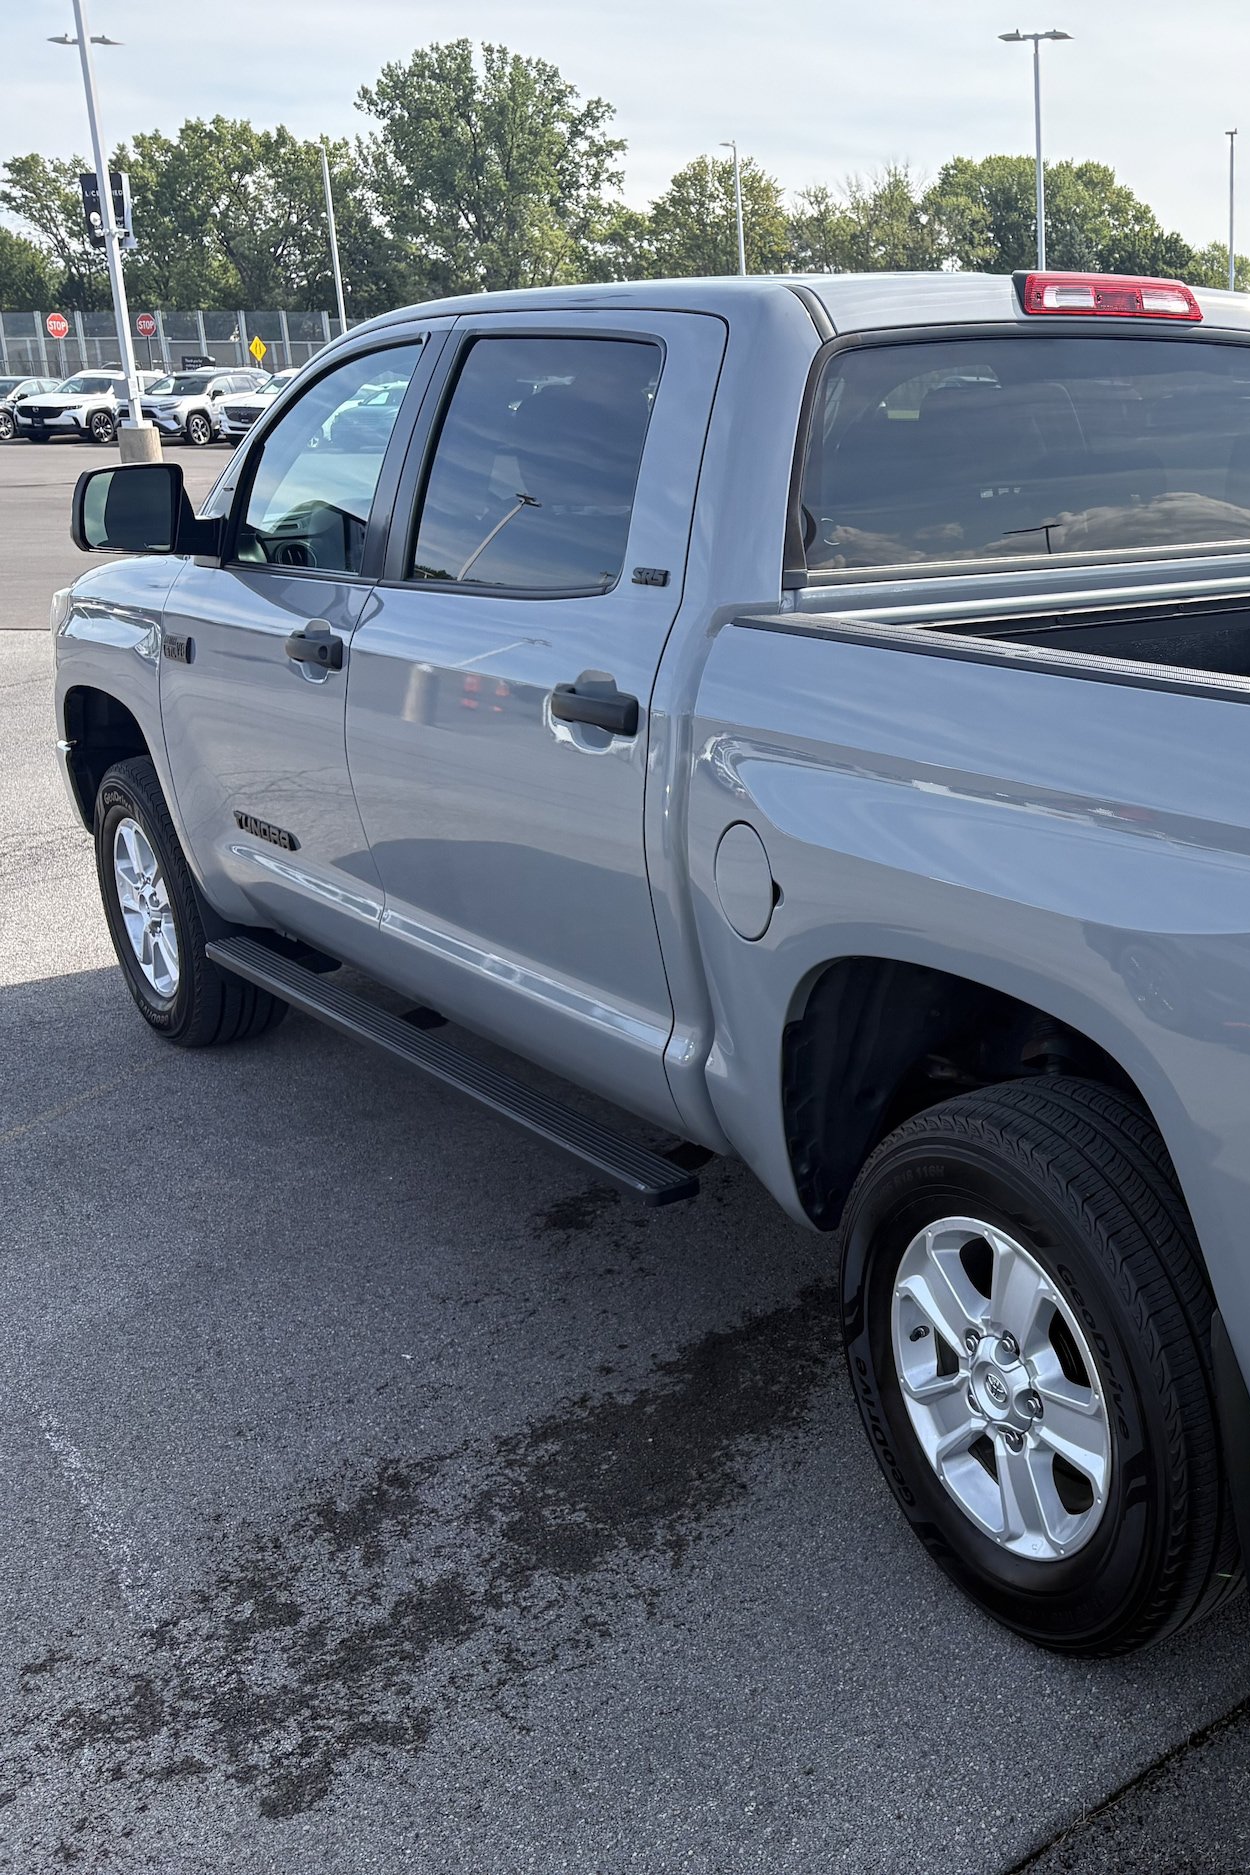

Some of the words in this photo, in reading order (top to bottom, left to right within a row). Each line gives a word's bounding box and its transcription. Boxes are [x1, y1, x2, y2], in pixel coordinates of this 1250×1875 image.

[48, 320, 67, 331] STOP
[138, 320, 155, 330] STOP
[632, 567, 669, 588] SR5
[234, 810, 297, 851] TUNDRA
[1056, 1262, 1130, 1441] GeoDrive
[855, 1355, 917, 1508] GeoDrive
